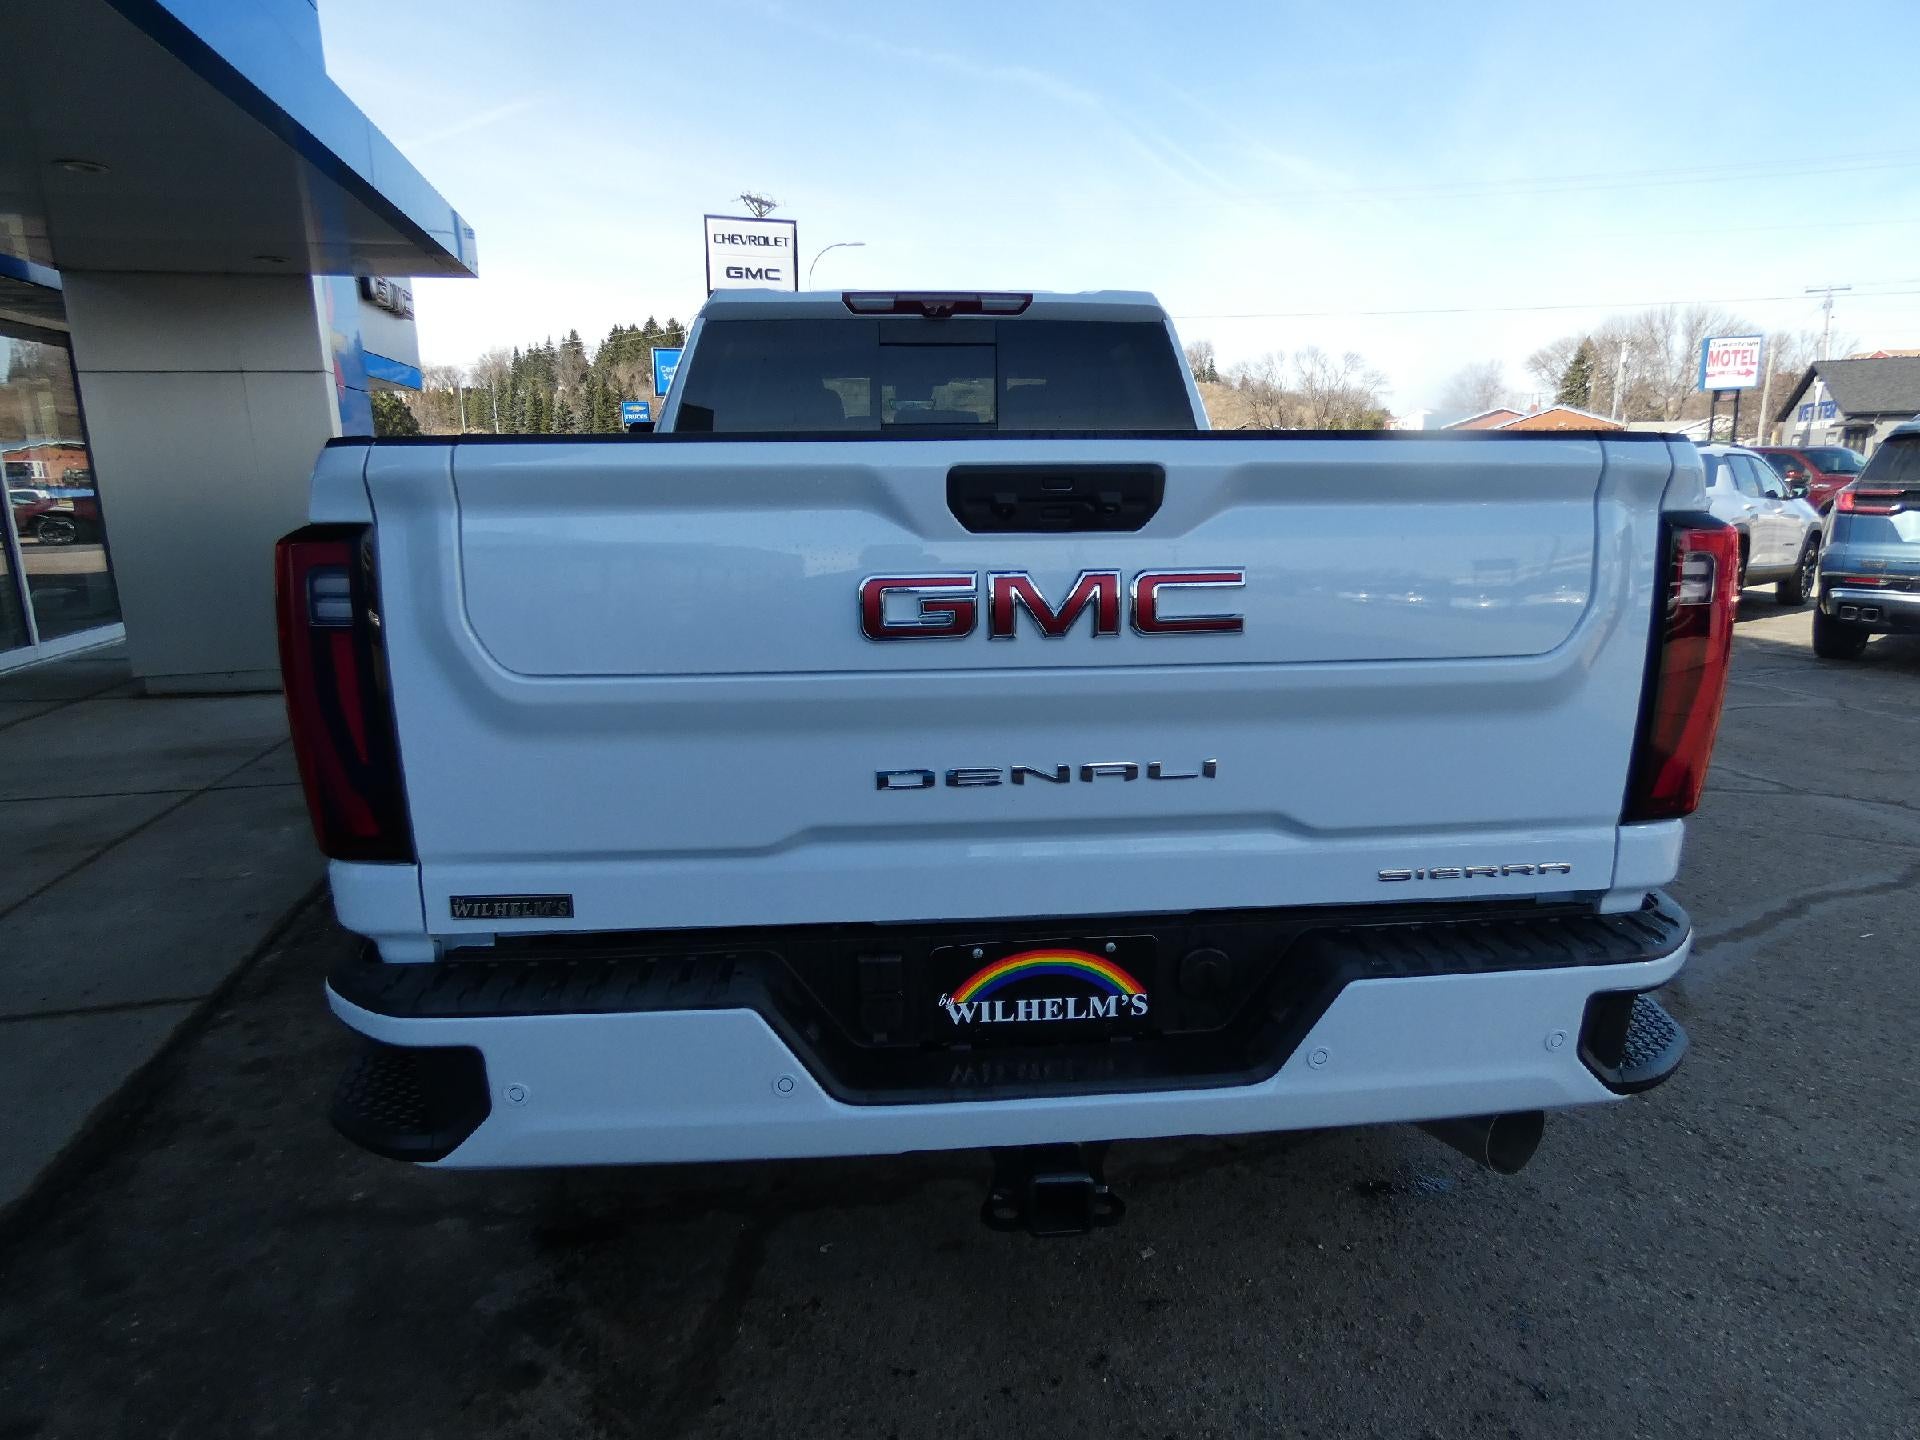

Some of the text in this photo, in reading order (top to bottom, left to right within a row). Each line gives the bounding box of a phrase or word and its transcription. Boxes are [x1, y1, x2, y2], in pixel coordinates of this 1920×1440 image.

[713, 232, 790, 248] CHEVROLET
[725, 266, 781, 281] GMC
[1707, 349, 1757, 367] MOTEL
[858, 565, 1247, 643] GMC
[875, 757, 1218, 791] DENALI
[1377, 861, 1572, 882] SIERRA
[452, 901, 569, 917] WILHELM'S
[938, 993, 1149, 1026] by WILHELM'S
